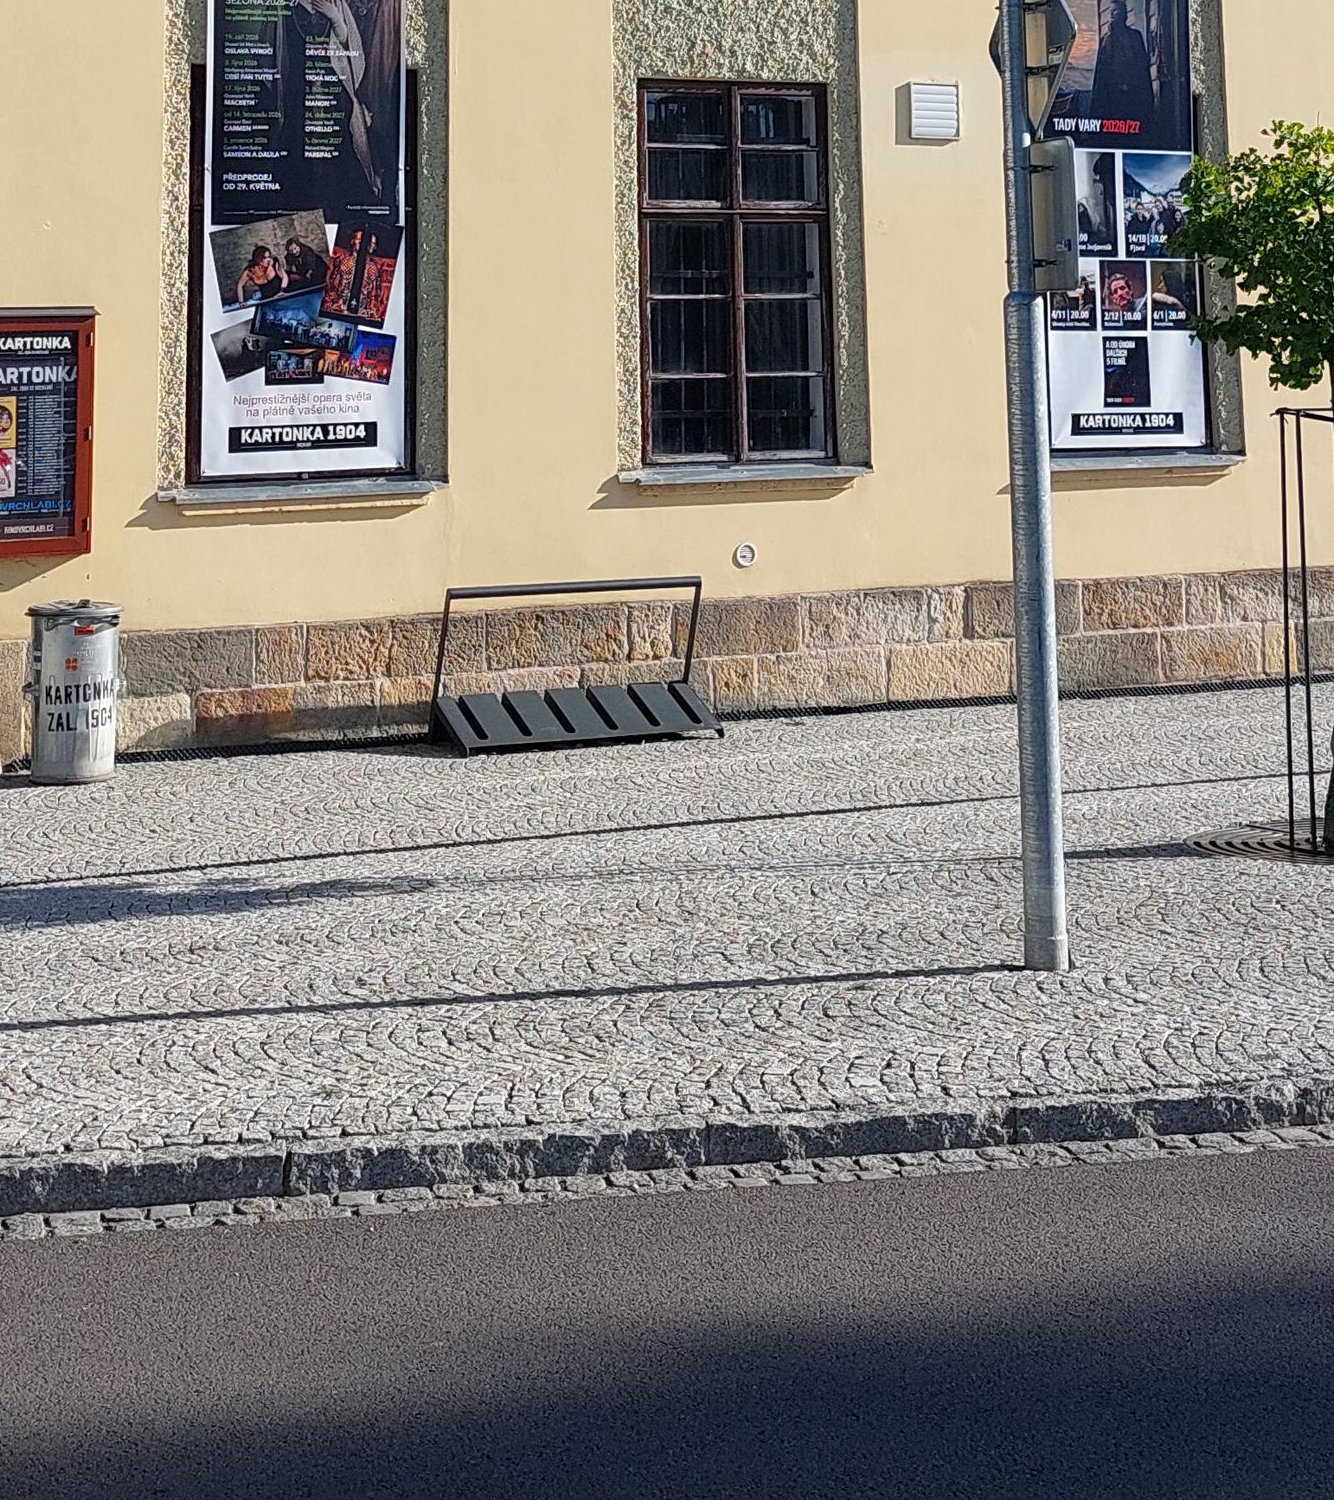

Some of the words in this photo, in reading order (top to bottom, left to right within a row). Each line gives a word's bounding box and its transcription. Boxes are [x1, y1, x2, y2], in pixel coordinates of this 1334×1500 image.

[1053, 117, 1077, 131] TADY
[1078, 118, 1101, 132] VARY
[1102, 119, 1140, 133] 2026/27
[223, 182, 235, 190] OD
[249, 181, 282, 190] KVĚTNA
[1071, 310, 1089, 319] 20.00
[233, 393, 310, 407] Nejprestižnější
[313, 395, 342, 405] opera
[346, 392, 372, 402] světa
[246, 408, 259, 417] na
[262, 405, 295, 419] plátně
[298, 404, 336, 416] vašeho
[339, 403, 360, 414] kina
[1079, 414, 1142, 428] KARTONKA
[1145, 414, 1175, 427] 1904
[240, 426, 324, 443] KARTONKA
[327, 424, 366, 440] 1904
[45, 678, 114, 705] KARTONKA
[47, 711, 77, 732] ZAL.
